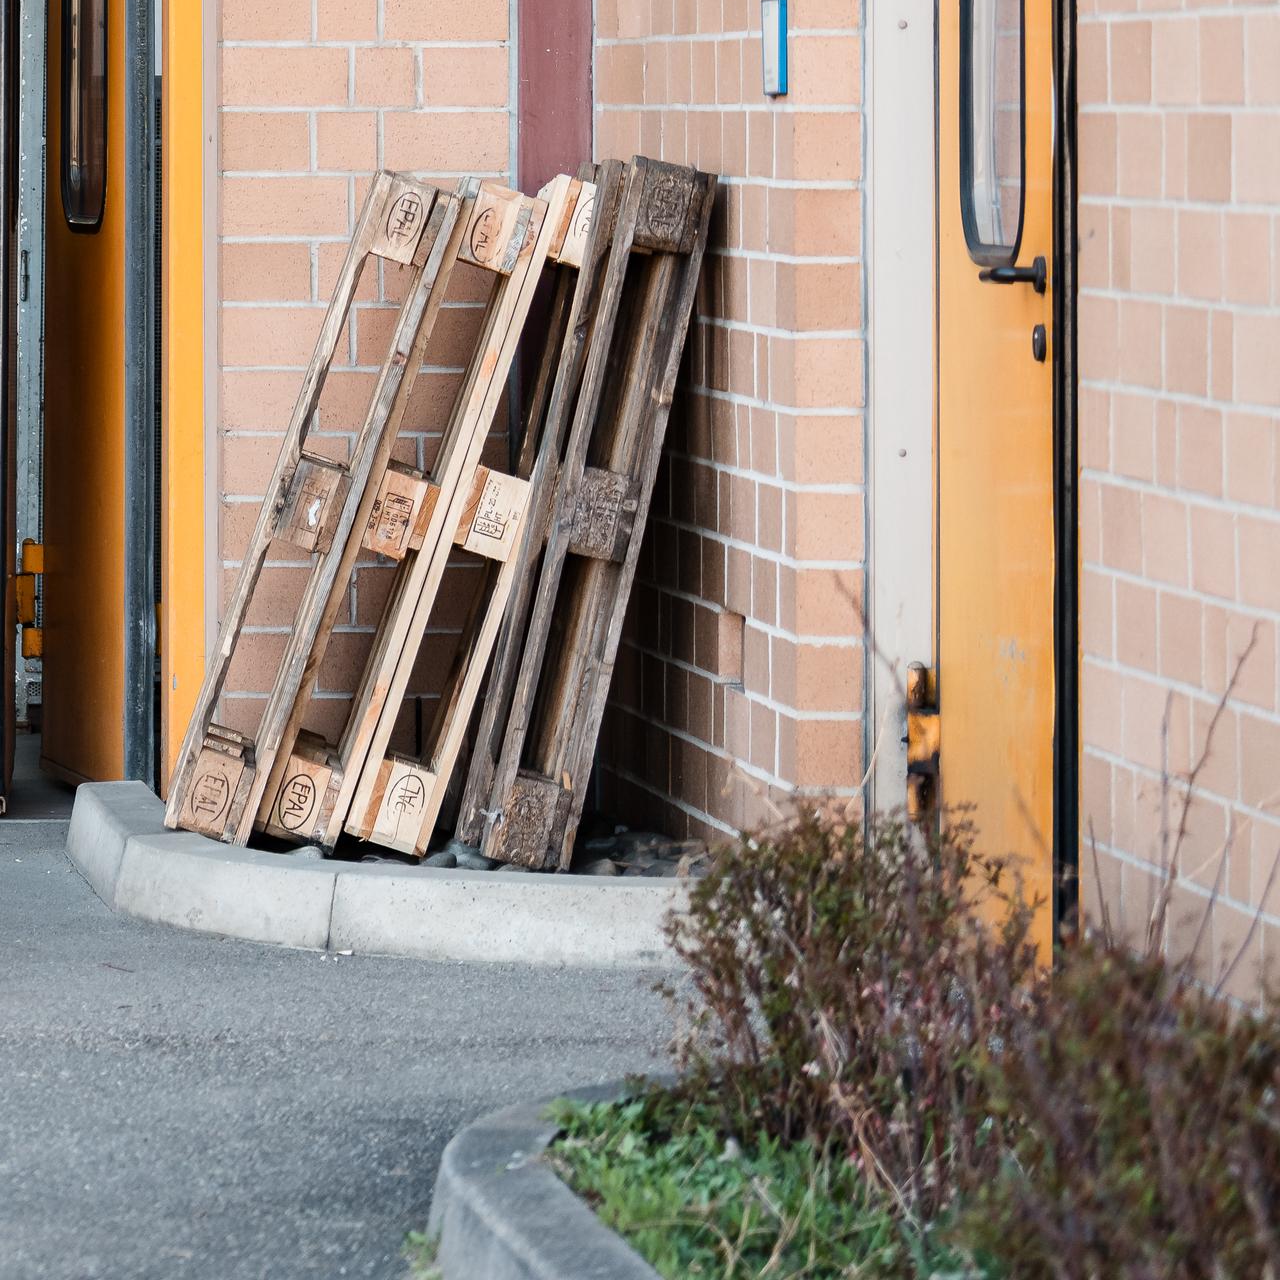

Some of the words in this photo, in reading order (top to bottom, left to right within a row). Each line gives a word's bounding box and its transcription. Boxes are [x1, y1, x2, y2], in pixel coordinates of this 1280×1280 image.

[390, 197, 420, 243] EPAL
[195, 774, 226, 815] EPAL
[282, 780, 312, 820] EPAL
